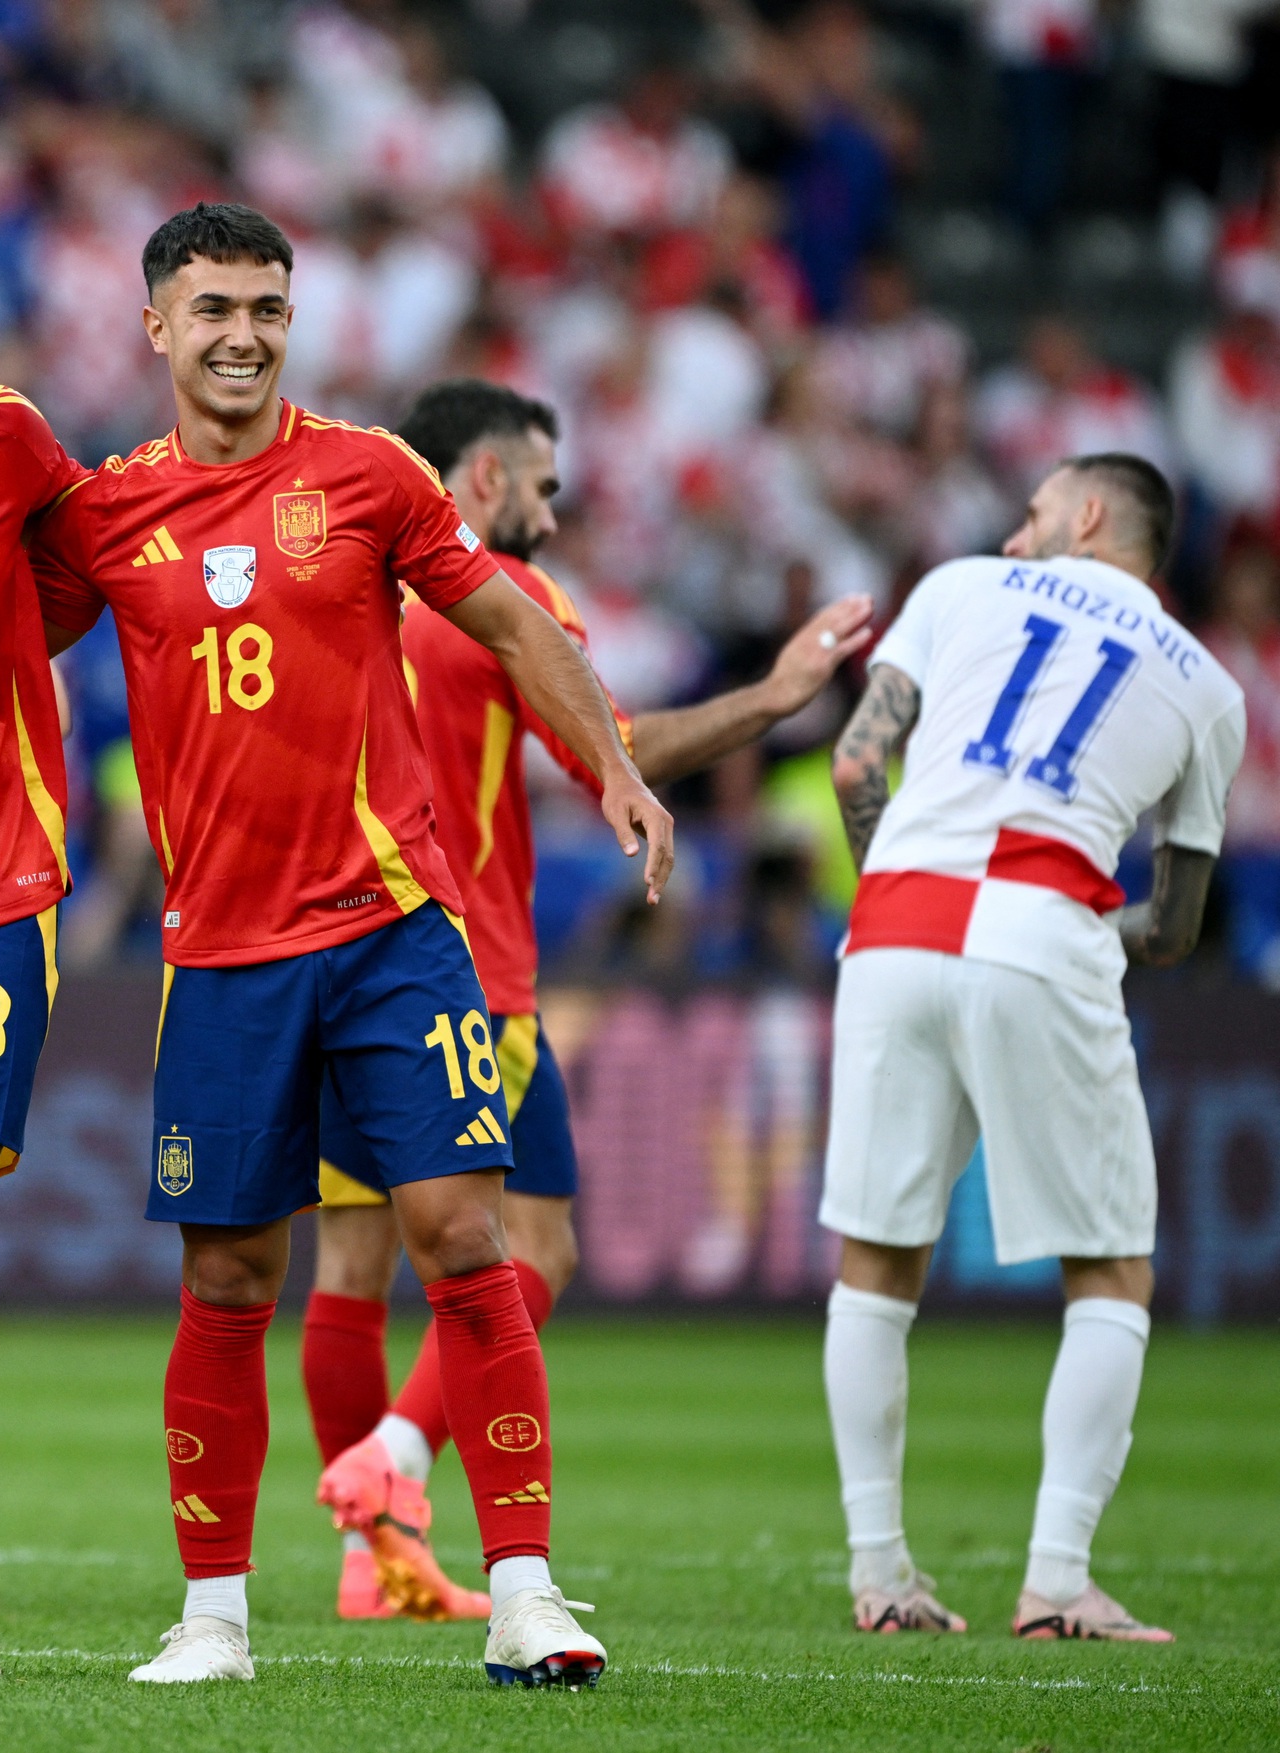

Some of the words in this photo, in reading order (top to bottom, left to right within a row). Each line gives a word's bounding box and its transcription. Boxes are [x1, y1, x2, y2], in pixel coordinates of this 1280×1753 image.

[191, 622, 275, 714] 18
[963, 613, 1140, 804] 11
[16, 871, 51, 887] HEAT.RDY
[337, 892, 377, 909] HEAT.RDY
[424, 1008, 501, 1099] 18
